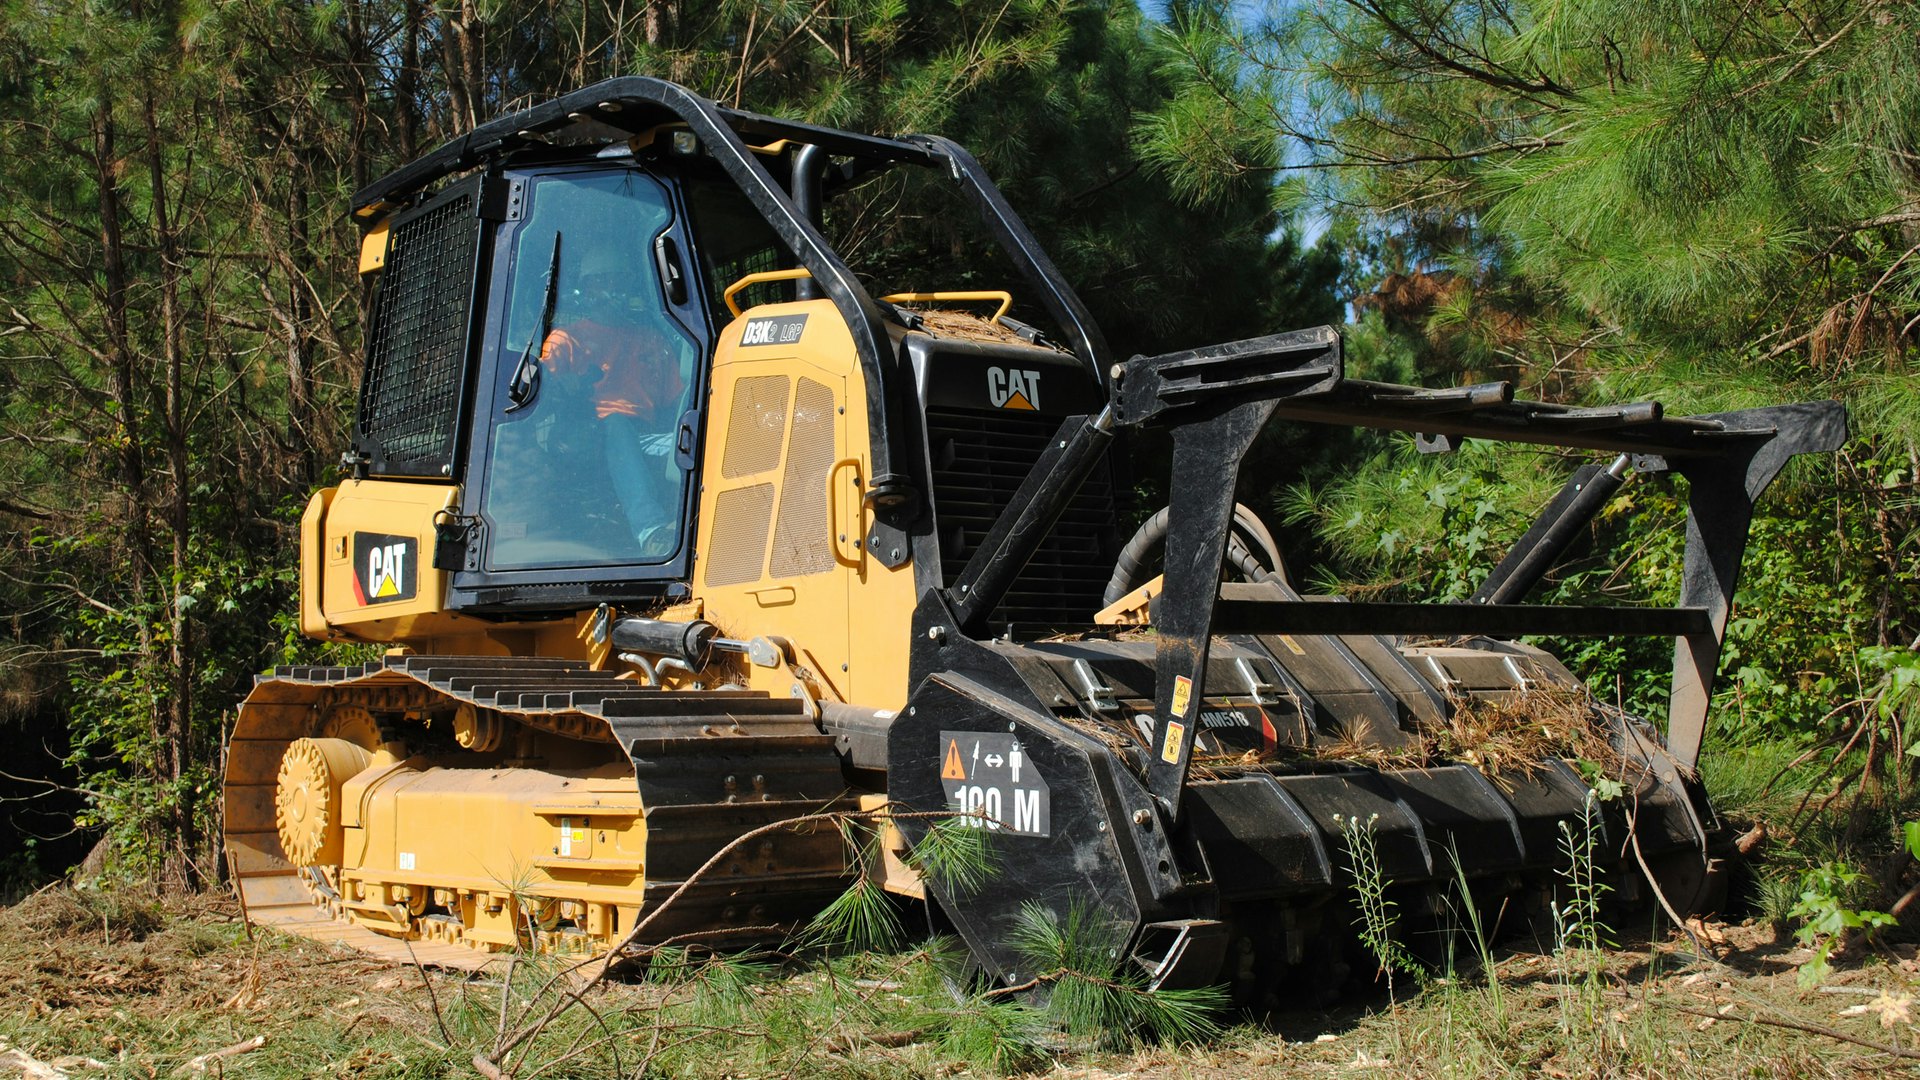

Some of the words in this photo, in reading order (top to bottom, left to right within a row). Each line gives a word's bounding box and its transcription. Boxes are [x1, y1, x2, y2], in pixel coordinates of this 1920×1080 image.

[780, 323, 803, 341] LGP
[987, 366, 1040, 411] CAT
[369, 543, 406, 598] CAT
[1200, 711, 1250, 728] HM518
[955, 785, 1001, 830] 100
[1014, 789, 1040, 833] M
